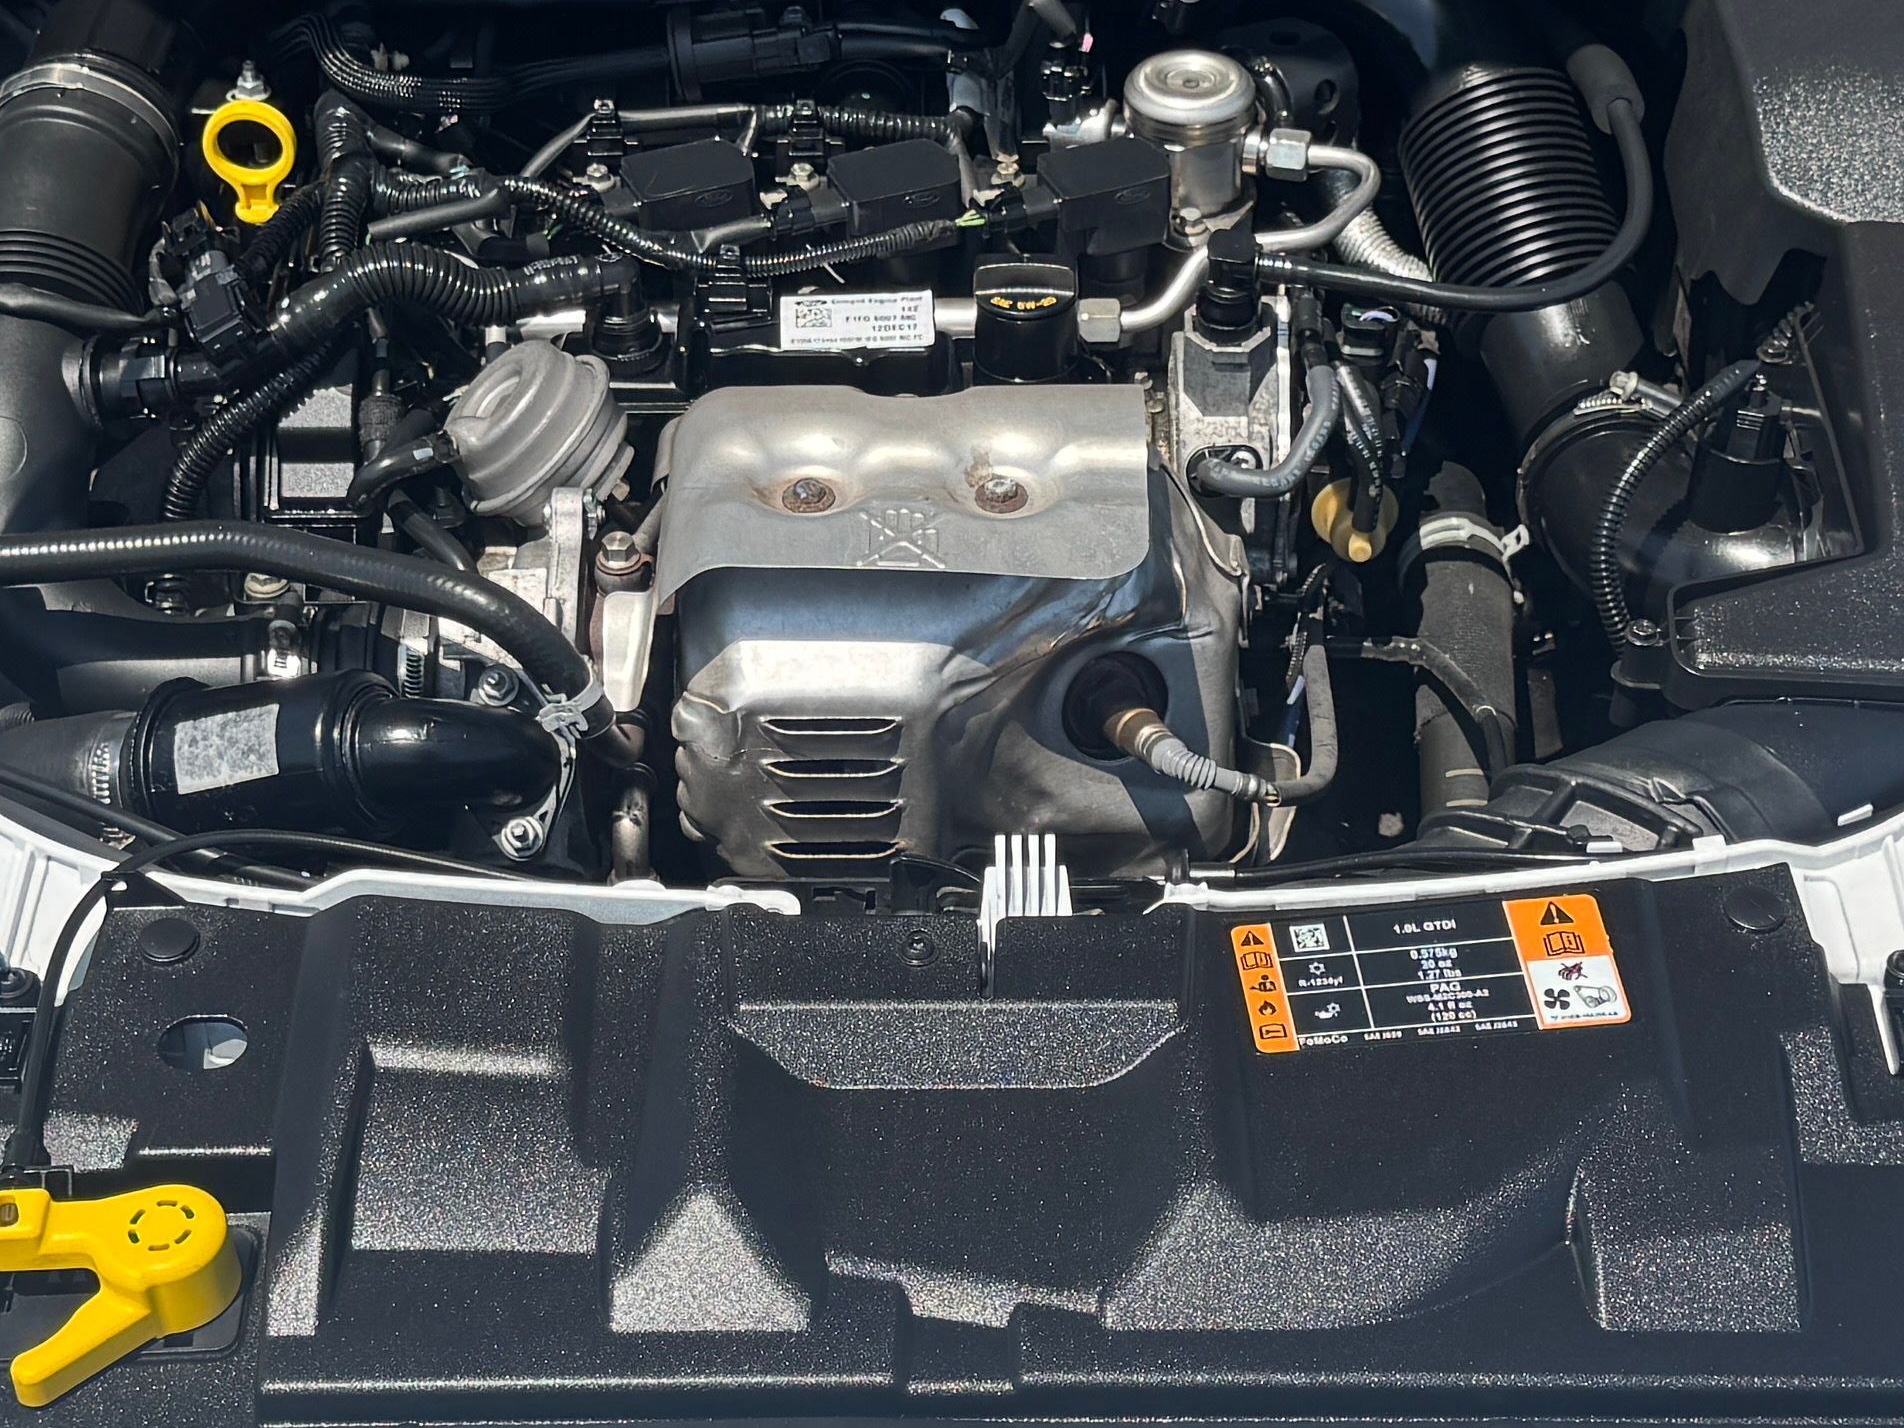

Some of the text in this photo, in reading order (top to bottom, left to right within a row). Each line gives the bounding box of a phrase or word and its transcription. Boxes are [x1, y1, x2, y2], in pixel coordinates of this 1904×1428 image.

[1393, 923, 1421, 934] 1.0L
[1421, 960, 1435, 970] 20
[1417, 968, 1462, 980] 1.27 lbs
[1430, 981, 1461, 993] PAG
[1428, 1002, 1444, 1011] 4.1
[1299, 1034, 1348, 1046] FoMoCo
